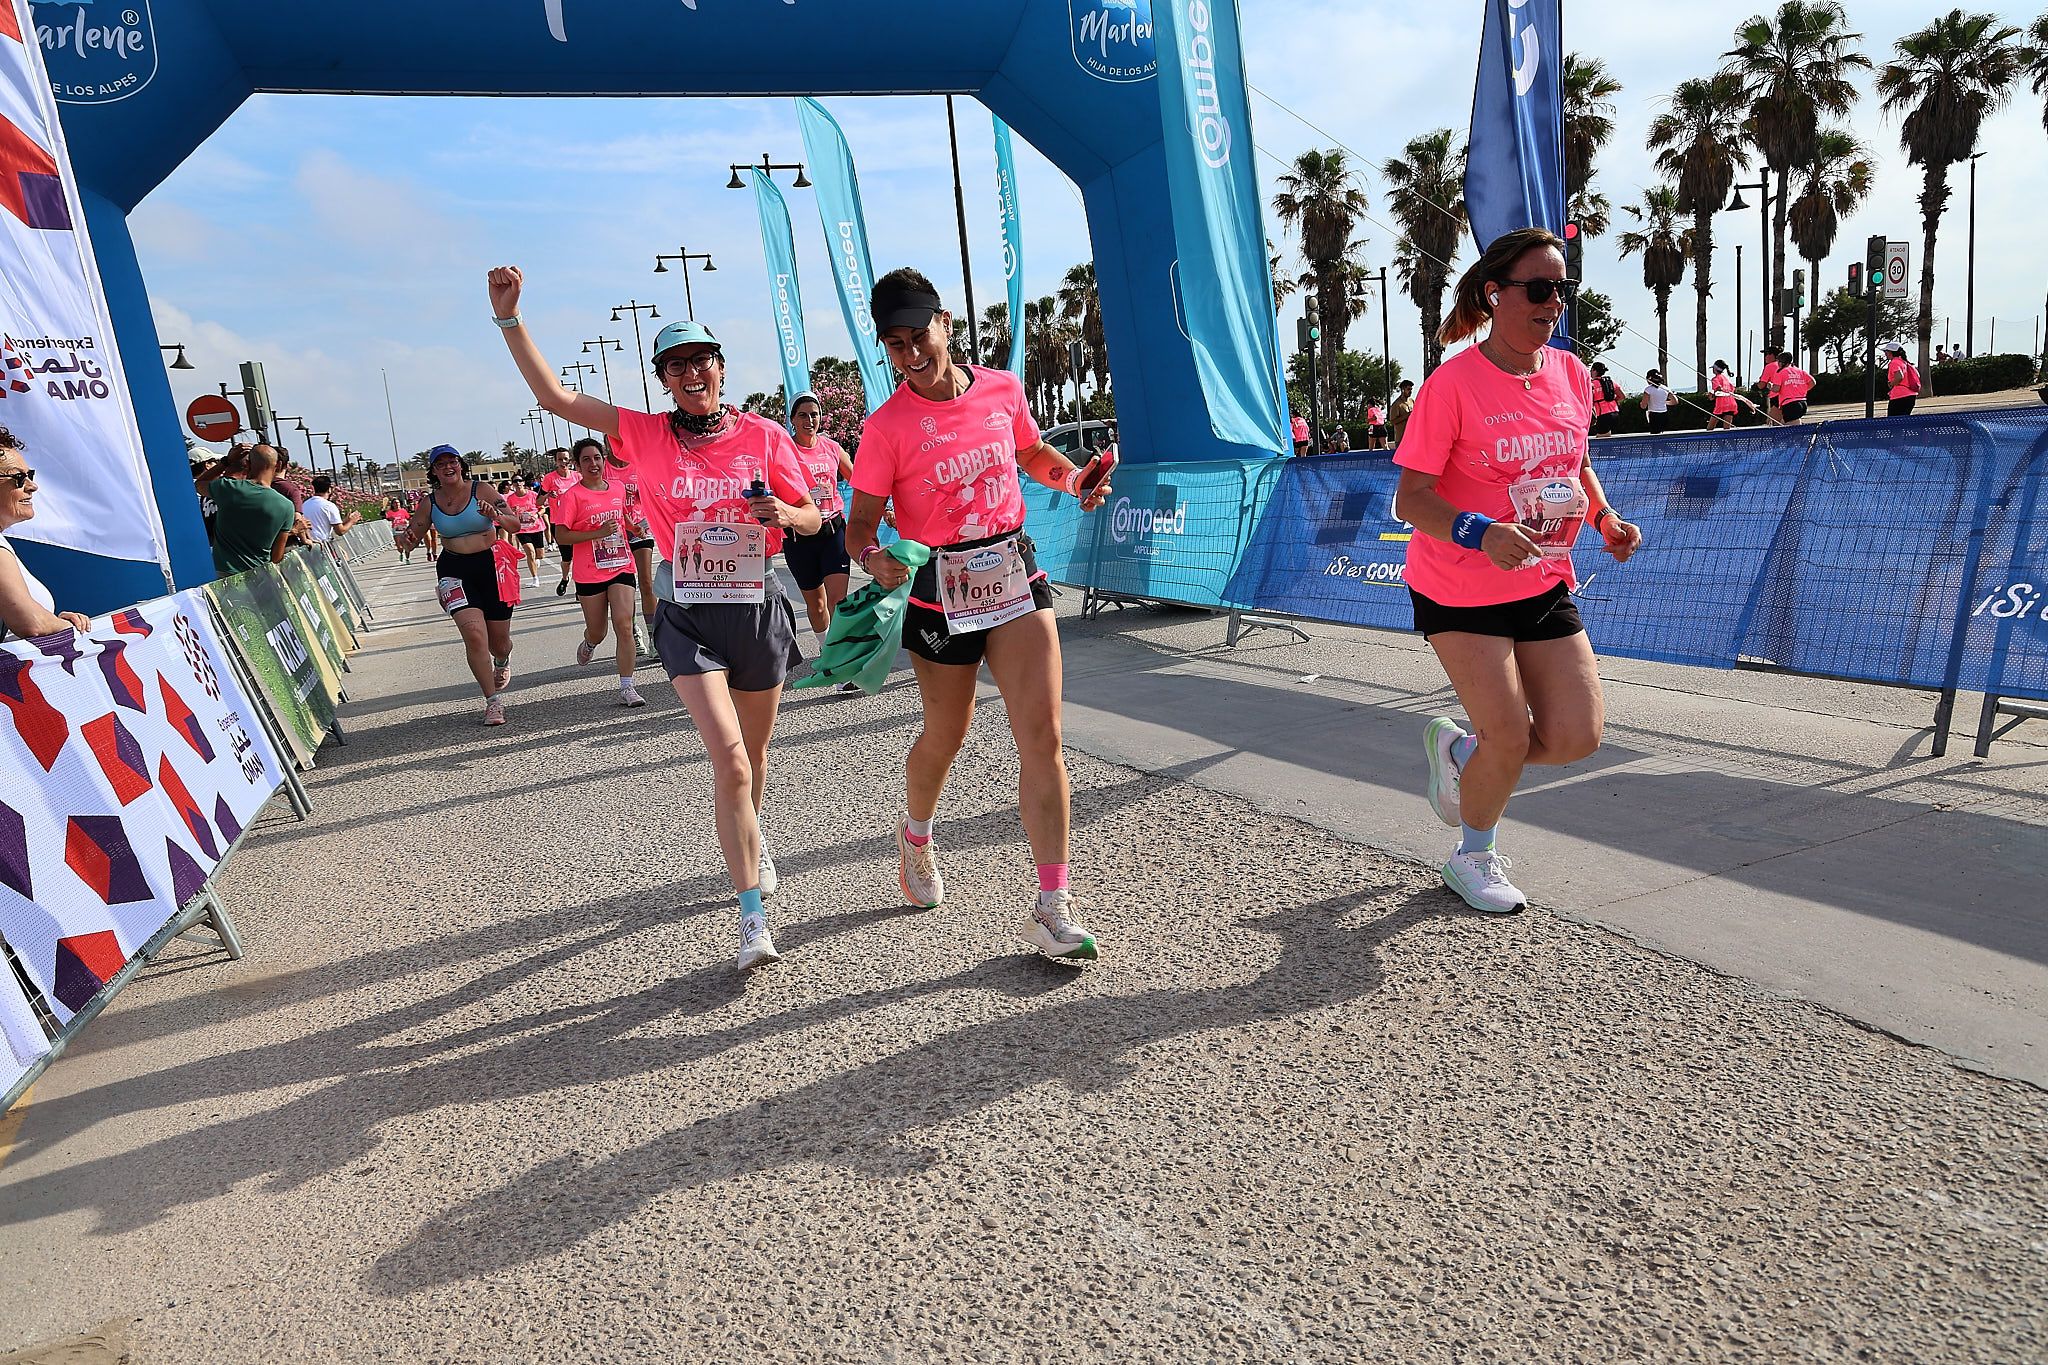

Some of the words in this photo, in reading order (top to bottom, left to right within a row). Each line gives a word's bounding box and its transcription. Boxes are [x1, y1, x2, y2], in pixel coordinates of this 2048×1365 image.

[33, 5, 144, 59] arlene
[1086, 57, 1106, 74] HIJA
[1109, 67, 1122, 77] DE
[1124, 65, 1142, 76] LOS
[52, 82, 61, 93] E
[66, 84, 95, 96] LOS
[99, 72, 138, 95] ALPES
[1891, 265, 1902, 275] 30
[1484, 410, 1524, 426] OYSHO
[921, 431, 958, 452] OYSHO
[1112, 496, 1186, 542] Compeed
[1542, 518, 1563, 533] 016
[703, 533, 736, 542] ASTURIANA
[703, 559, 737, 573] 016
[969, 557, 1001, 570] ASTURIANA
[1347, 565, 1366, 578] es
[970, 581, 1003, 600] 016
[958, 618, 984, 629] OYSHO
[241, 752, 266, 785] OMAN
